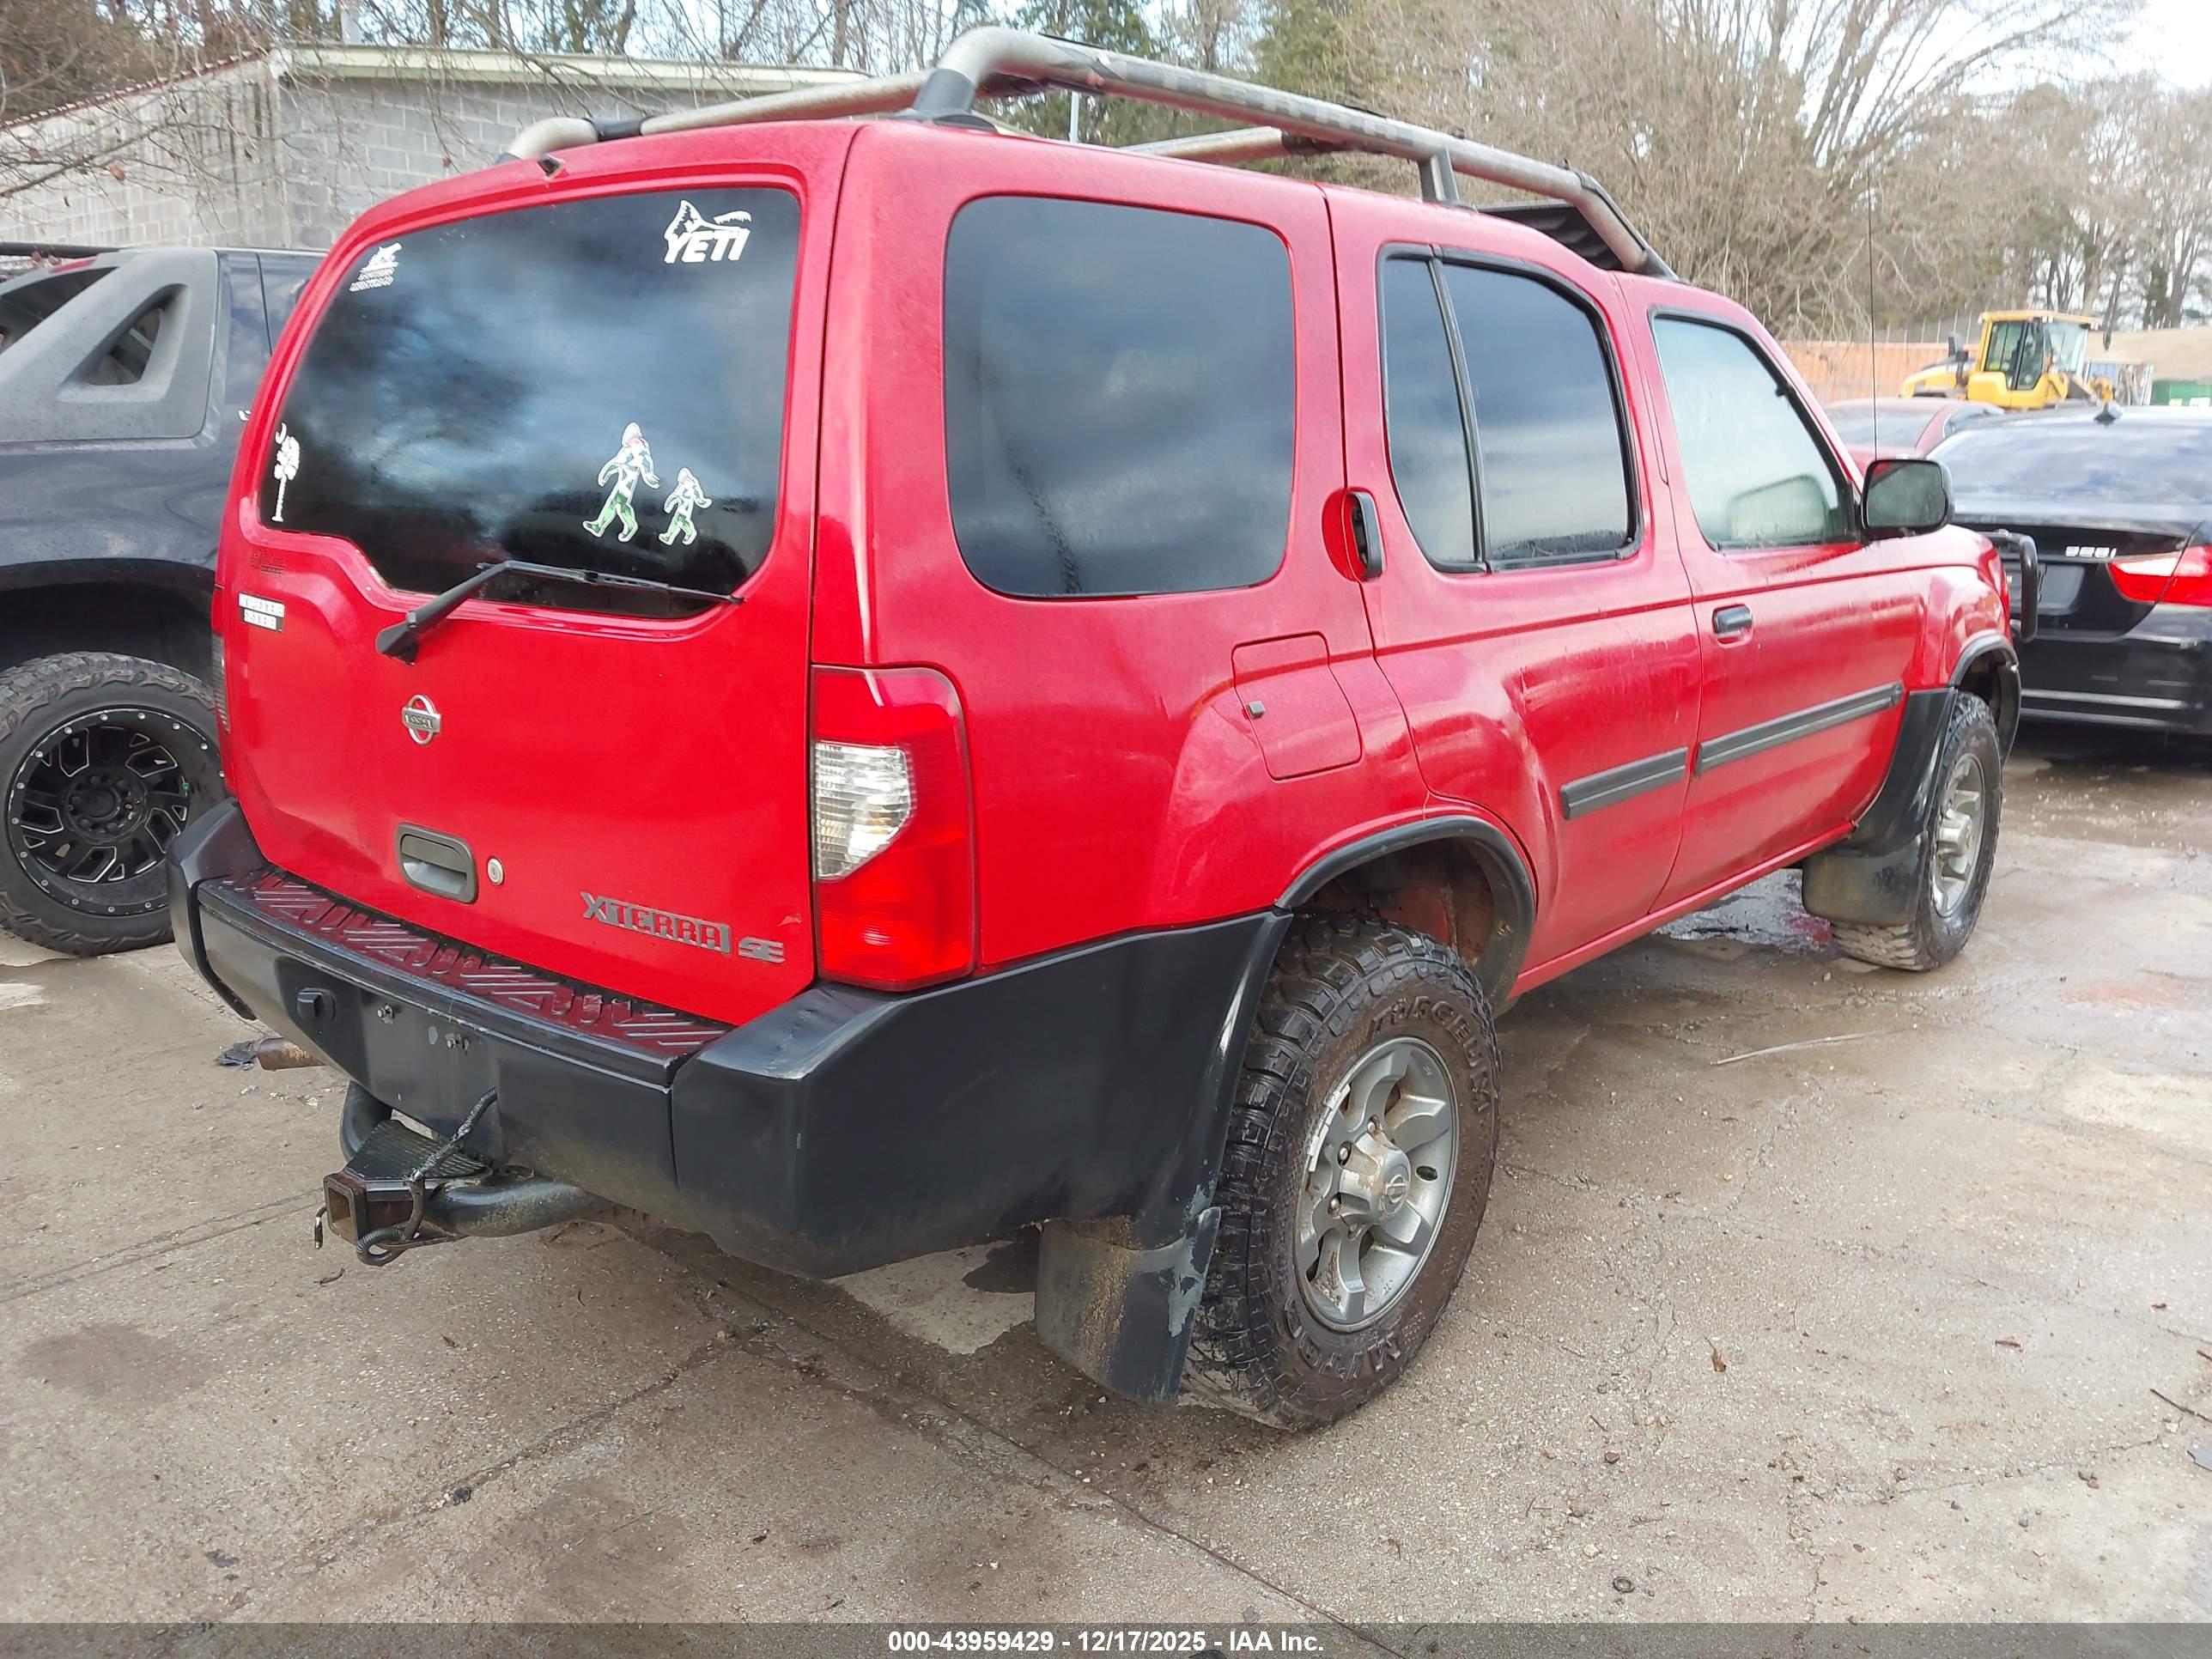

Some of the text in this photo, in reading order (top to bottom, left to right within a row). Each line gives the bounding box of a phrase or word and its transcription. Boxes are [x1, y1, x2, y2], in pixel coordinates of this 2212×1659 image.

[664, 228, 750, 264] YETI
[580, 891, 786, 964] XTERRA SE
